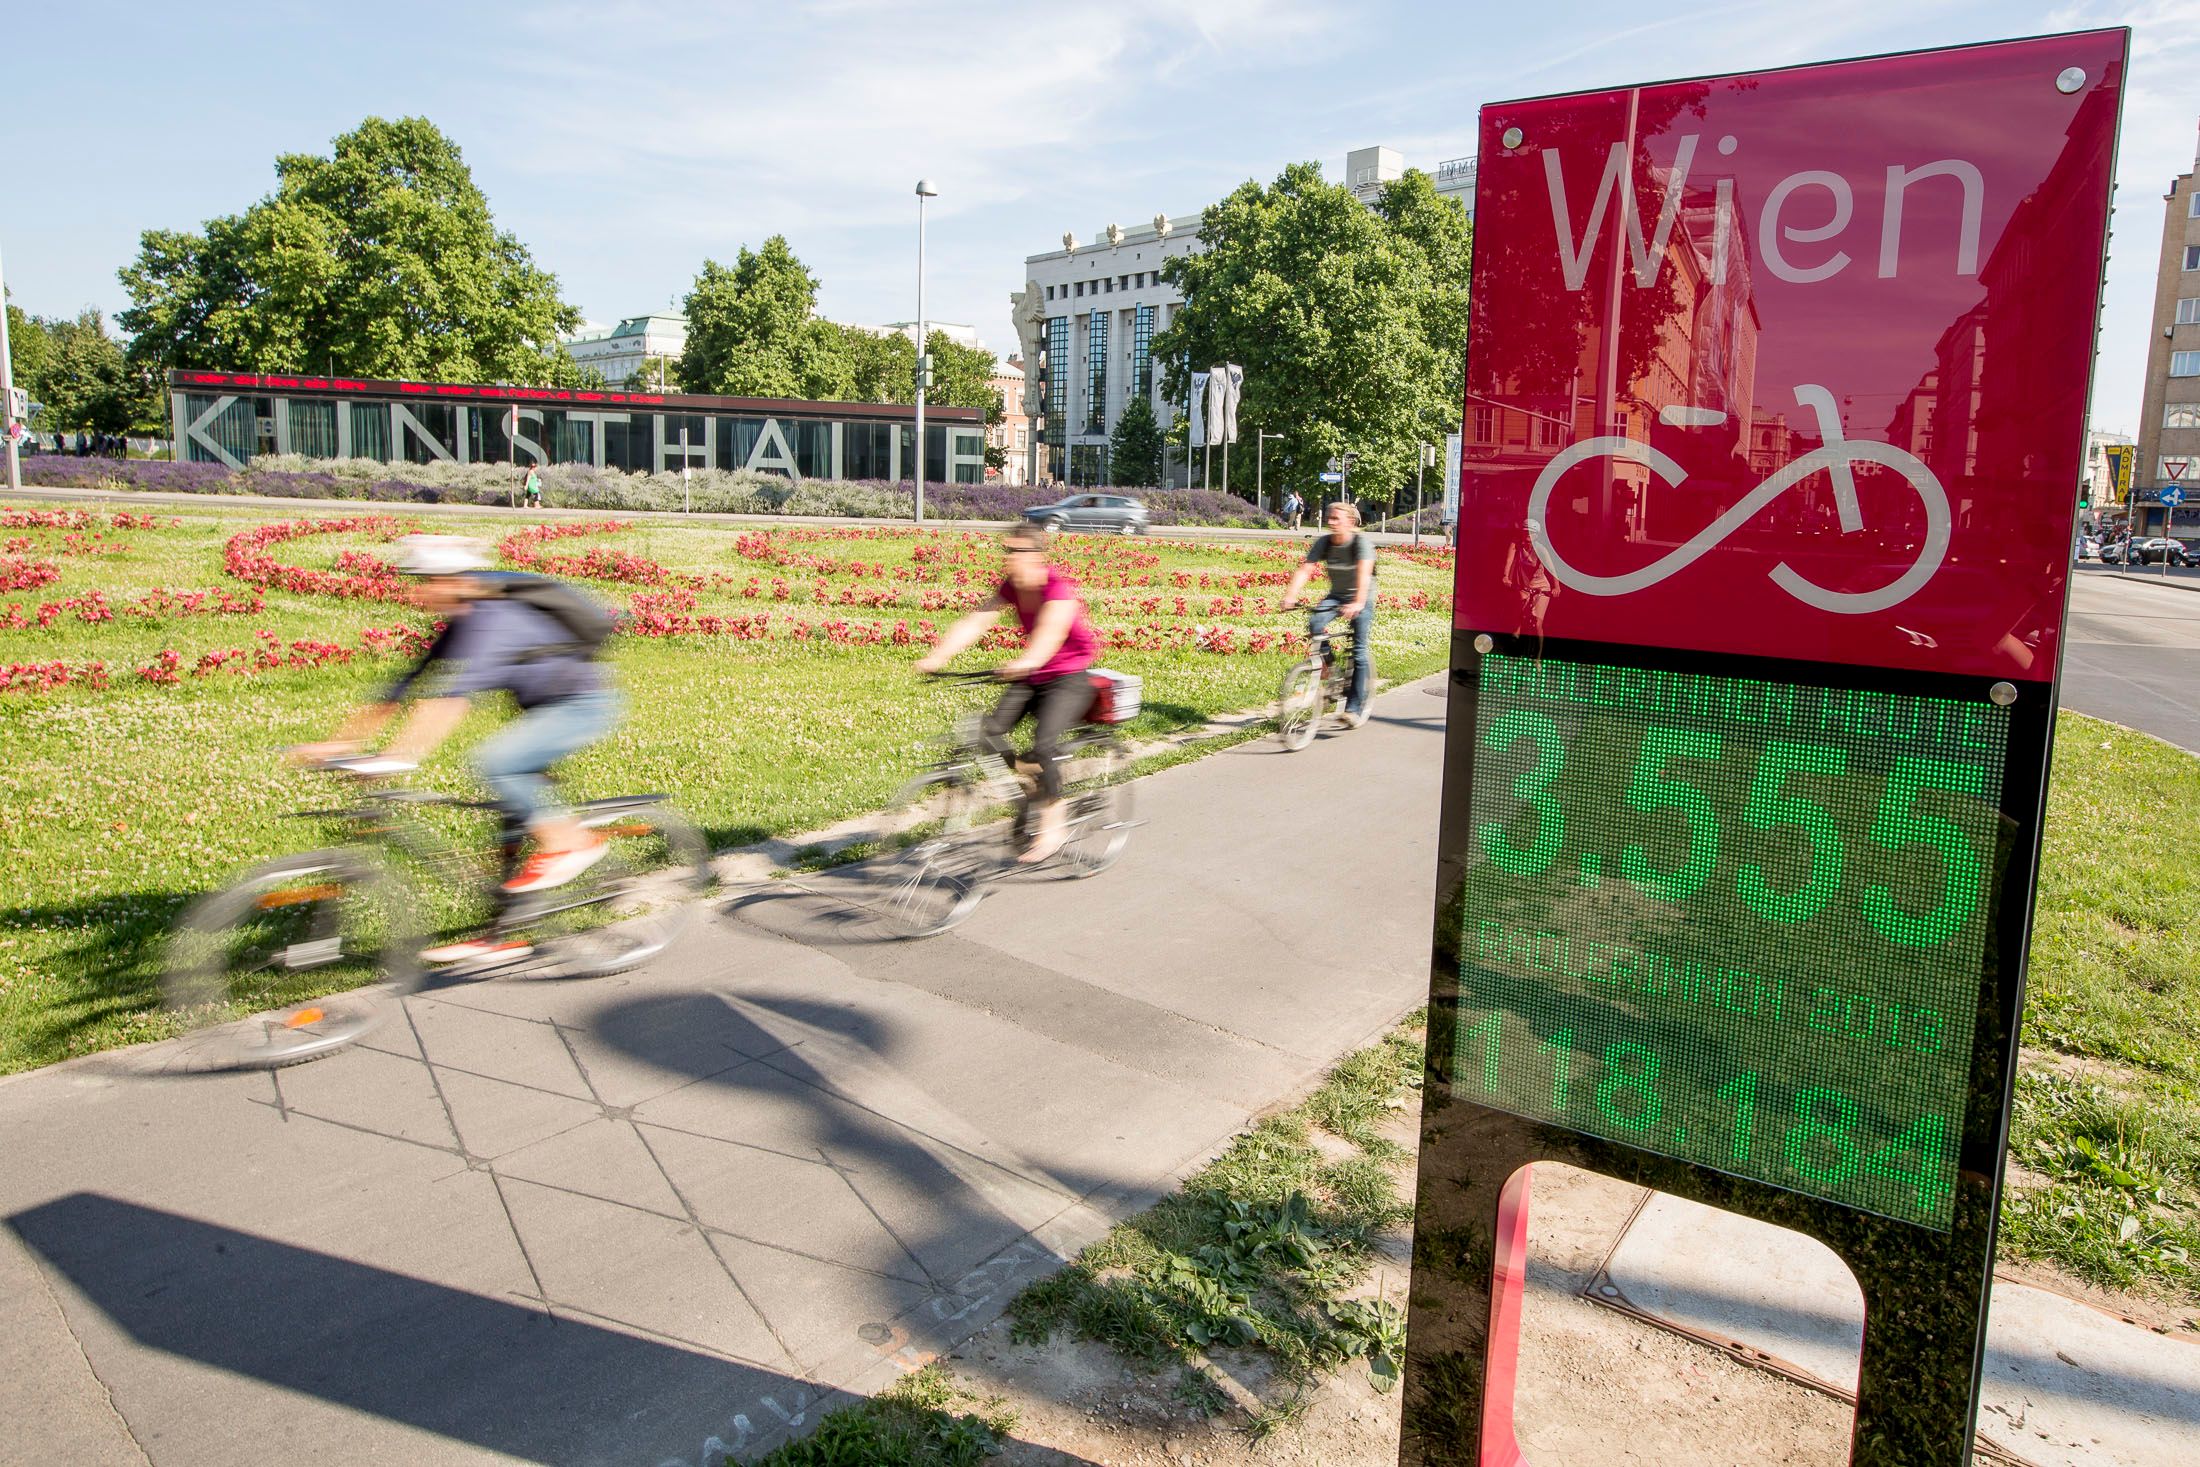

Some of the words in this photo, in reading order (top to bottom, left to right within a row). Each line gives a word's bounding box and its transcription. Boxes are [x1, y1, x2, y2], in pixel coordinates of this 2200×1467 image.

[1541, 133, 1985, 292] Wien
[2118, 448, 2130, 502] ADMIRAL
[1819, 687, 1991, 749] HEUTE
[1478, 710, 1986, 949] 3.555
[1808, 987, 1945, 1055] 2013
[1468, 1010, 1951, 1212] 118.184
